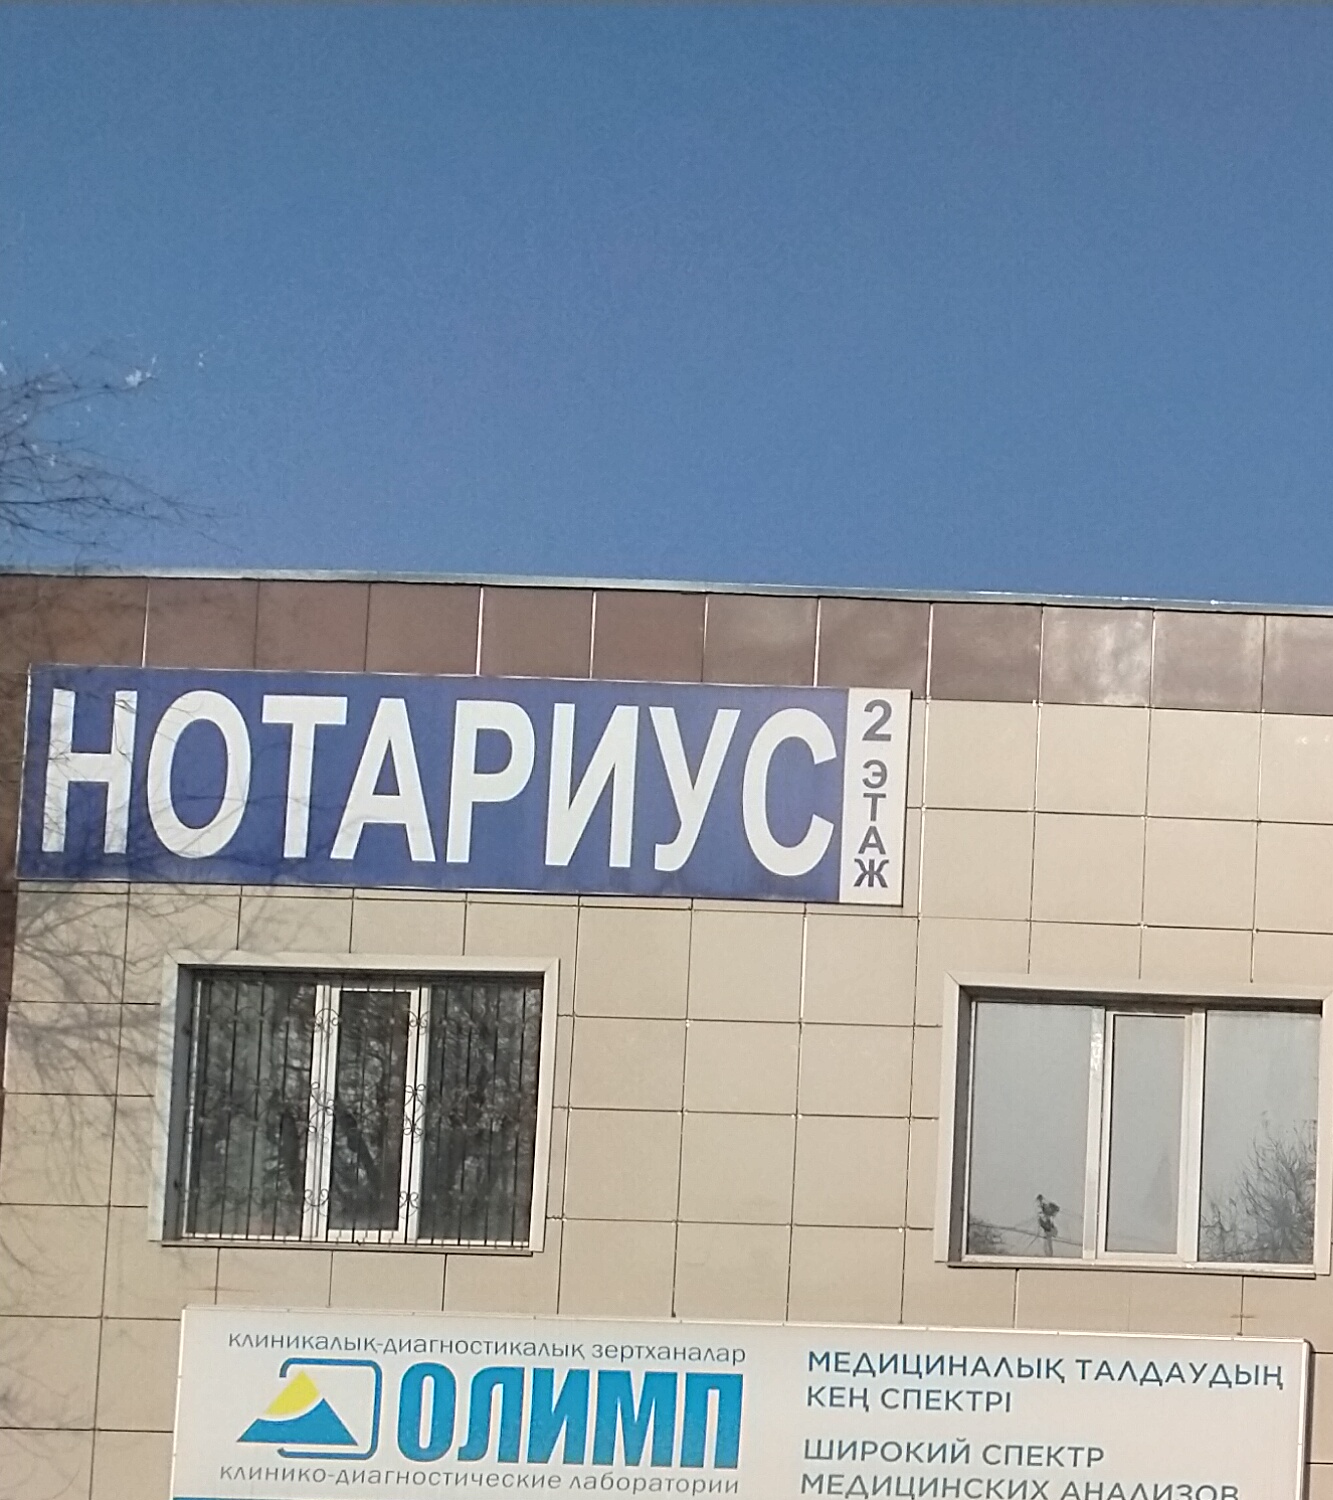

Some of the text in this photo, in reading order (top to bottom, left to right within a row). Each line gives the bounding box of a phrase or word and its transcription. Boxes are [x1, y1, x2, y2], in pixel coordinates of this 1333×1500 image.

[862, 699, 892, 741] 2
[42, 688, 837, 877] НОТАРИУС
[853, 759, 890, 888] ЭТАЖ
[229, 1332, 747, 1364] клиникалық-диагностикалық зертханалар
[808, 1350, 1285, 1390] МЕДИЦИНАЛЫҚ ТАЛДАУДЫҢ
[397, 1362, 744, 1469] ОЛИМП
[806, 1386, 1012, 1413] КЕҢ СПЕКТРІ
[803, 1437, 1105, 1468] ШИРОКИЙ СПЕКТР
[220, 1463, 740, 1495] клинико-диагностические лаборатории
